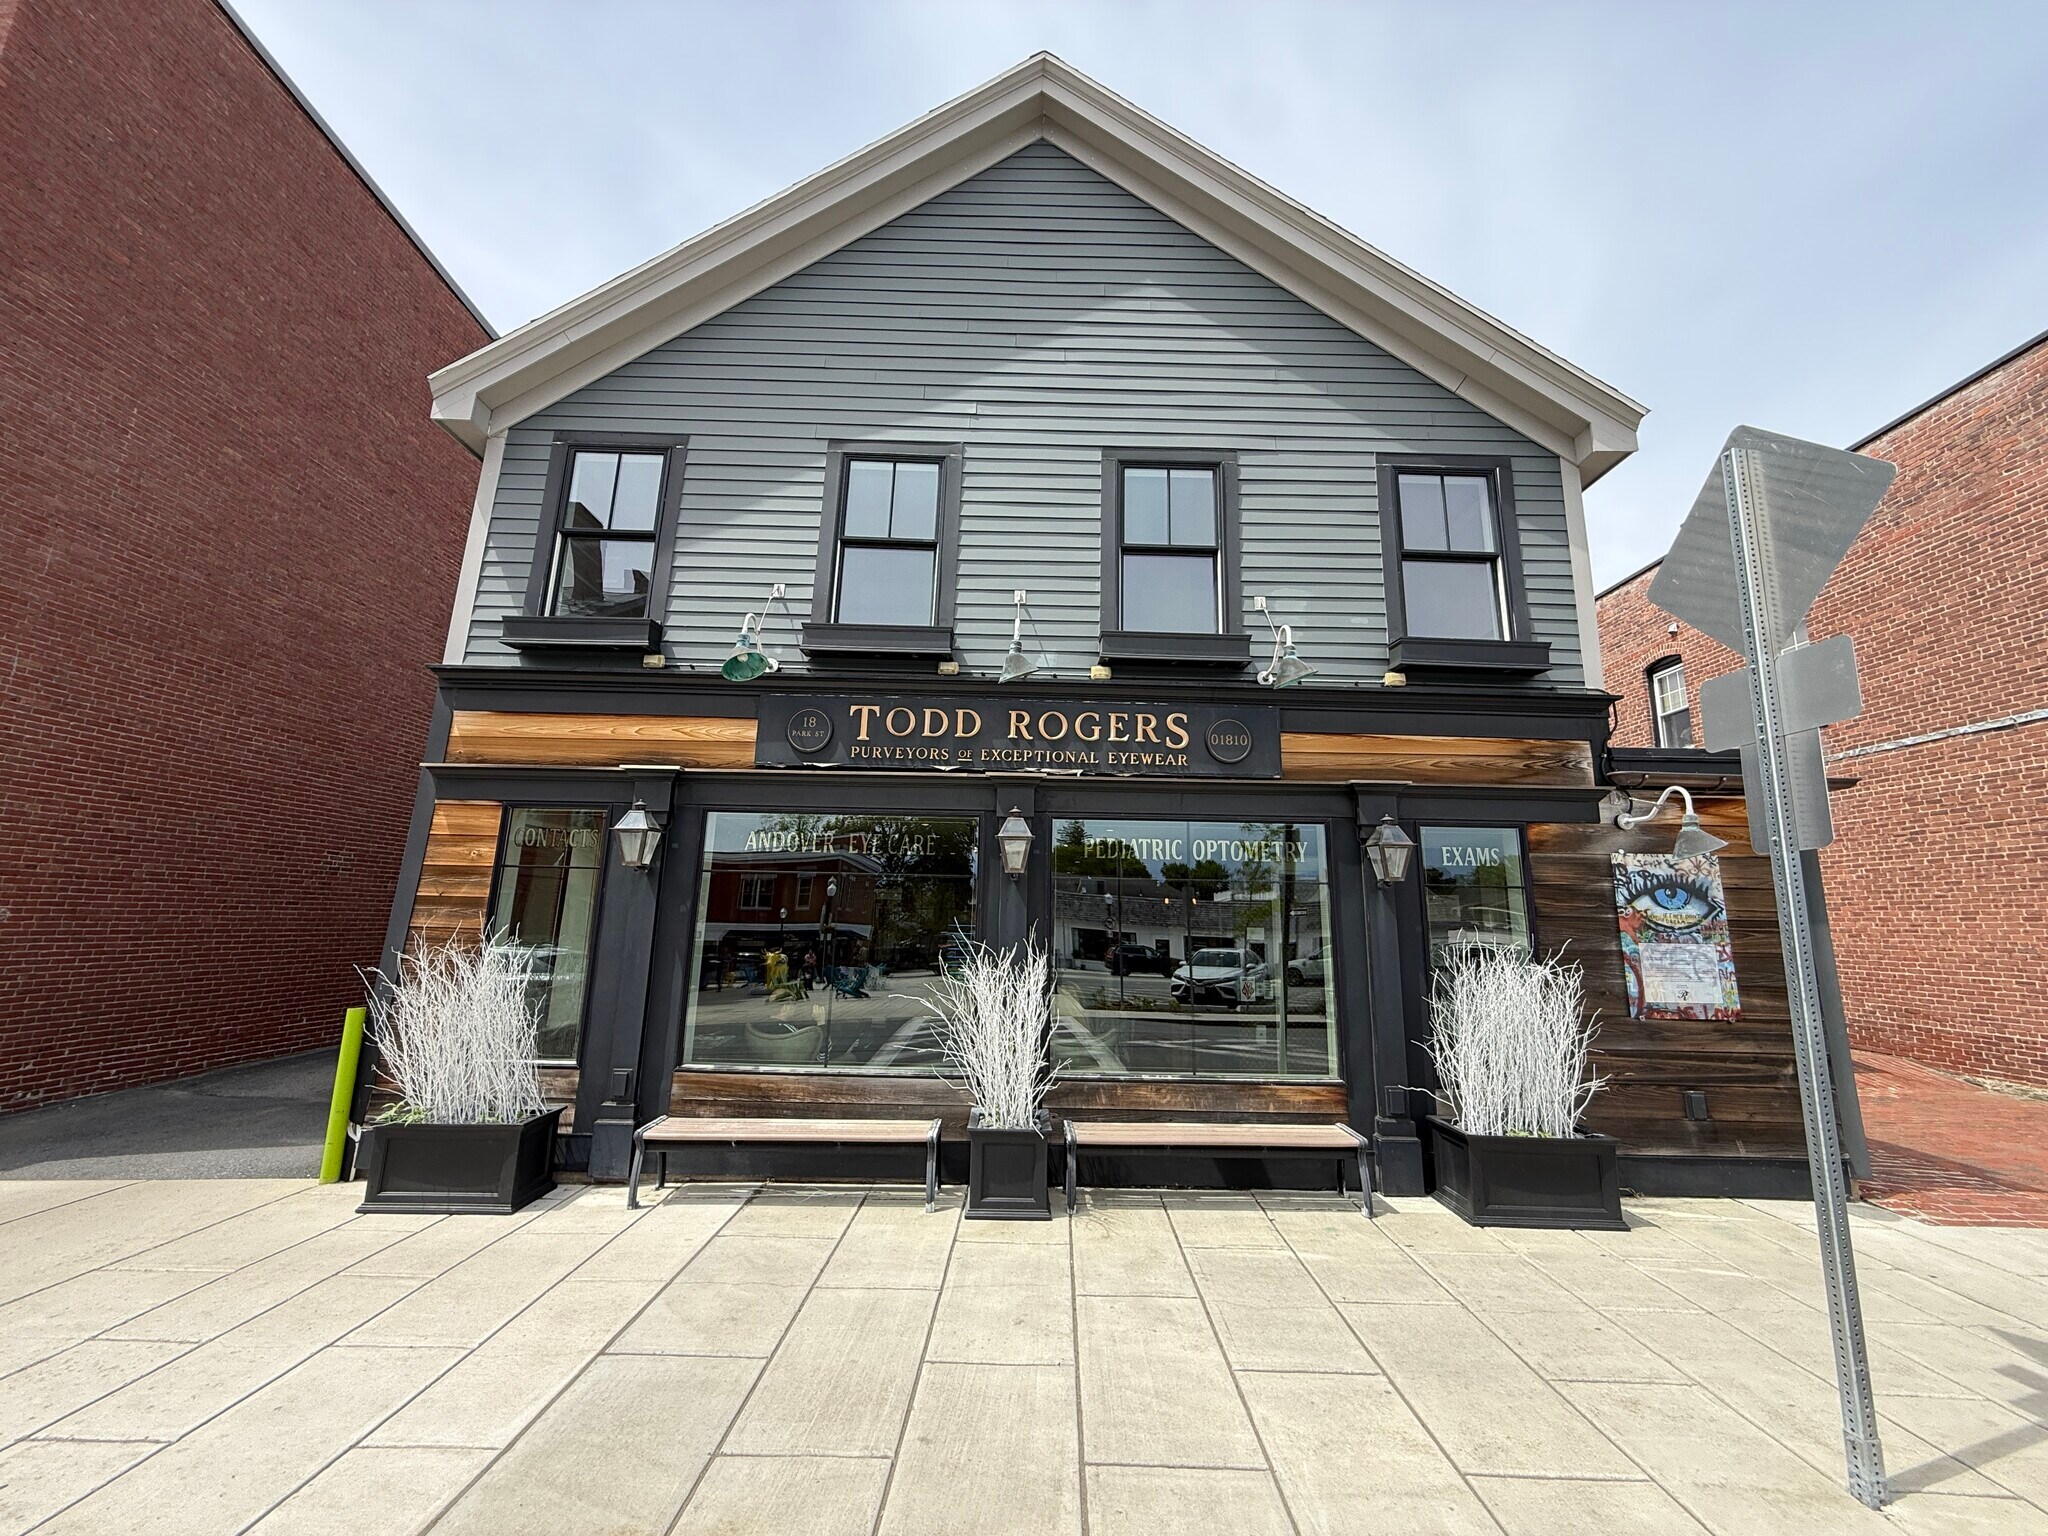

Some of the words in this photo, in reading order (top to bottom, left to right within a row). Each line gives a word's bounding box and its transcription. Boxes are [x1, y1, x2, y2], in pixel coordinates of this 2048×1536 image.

[803, 716, 817, 728] 18
[850, 705, 982, 741] TODD
[1007, 710, 1190, 749] ROGERS
[1211, 733, 1248, 746] 01810
[850, 746, 949, 760] PURVEYORS
[958, 749, 973, 761] OF
[981, 748, 1099, 764] EXCEPTIONAL
[1108, 752, 1188, 766] EYEWEAR
[513, 827, 599, 848] CONTACTS
[744, 830, 835, 854] ANDOVER
[1082, 837, 1183, 861] PEDIATRIC
[1192, 839, 1308, 863] OPTOMETRY
[1441, 846, 1501, 867] EXAMS
